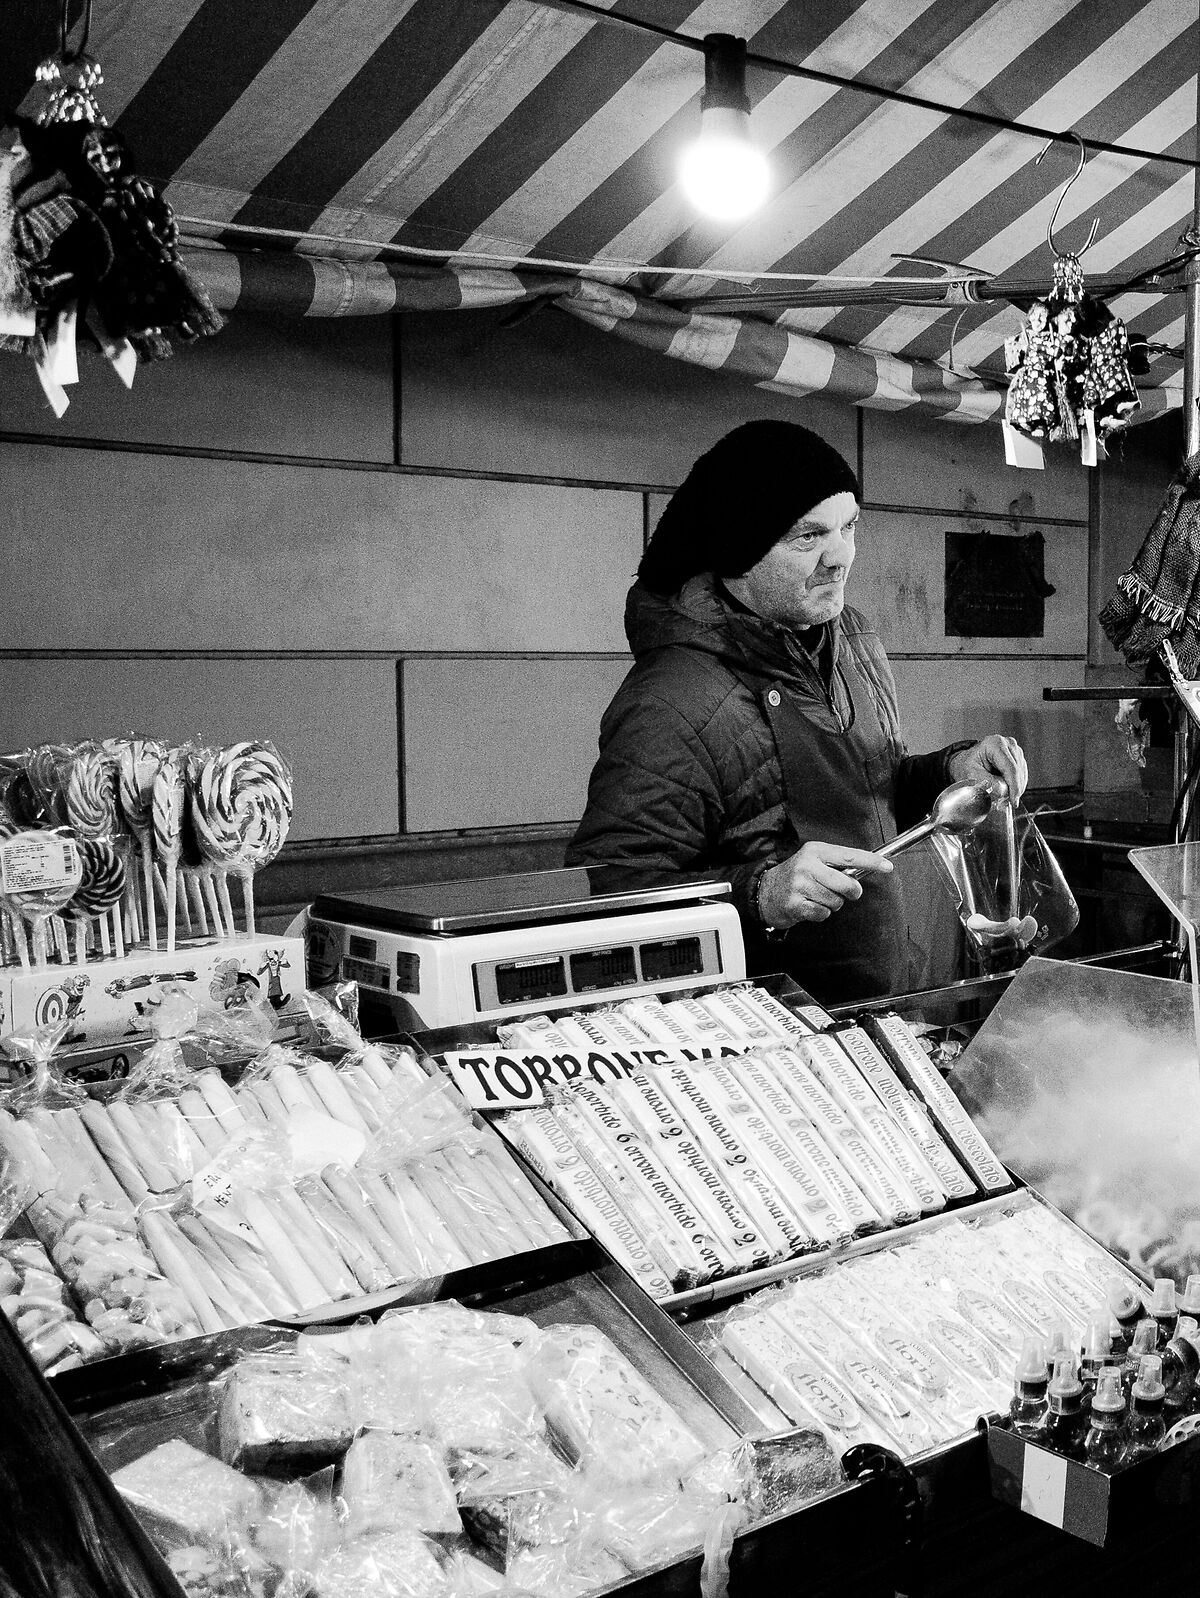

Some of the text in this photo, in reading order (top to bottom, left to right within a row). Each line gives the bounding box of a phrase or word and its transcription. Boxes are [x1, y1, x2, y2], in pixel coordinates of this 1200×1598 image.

[844, 1031, 883, 1073] Torrone
[678, 1141, 720, 1188] morbido
[652, 1181, 696, 1228] morbido
[797, 1373, 848, 1419] floris
[849, 1361, 882, 1390] flor
